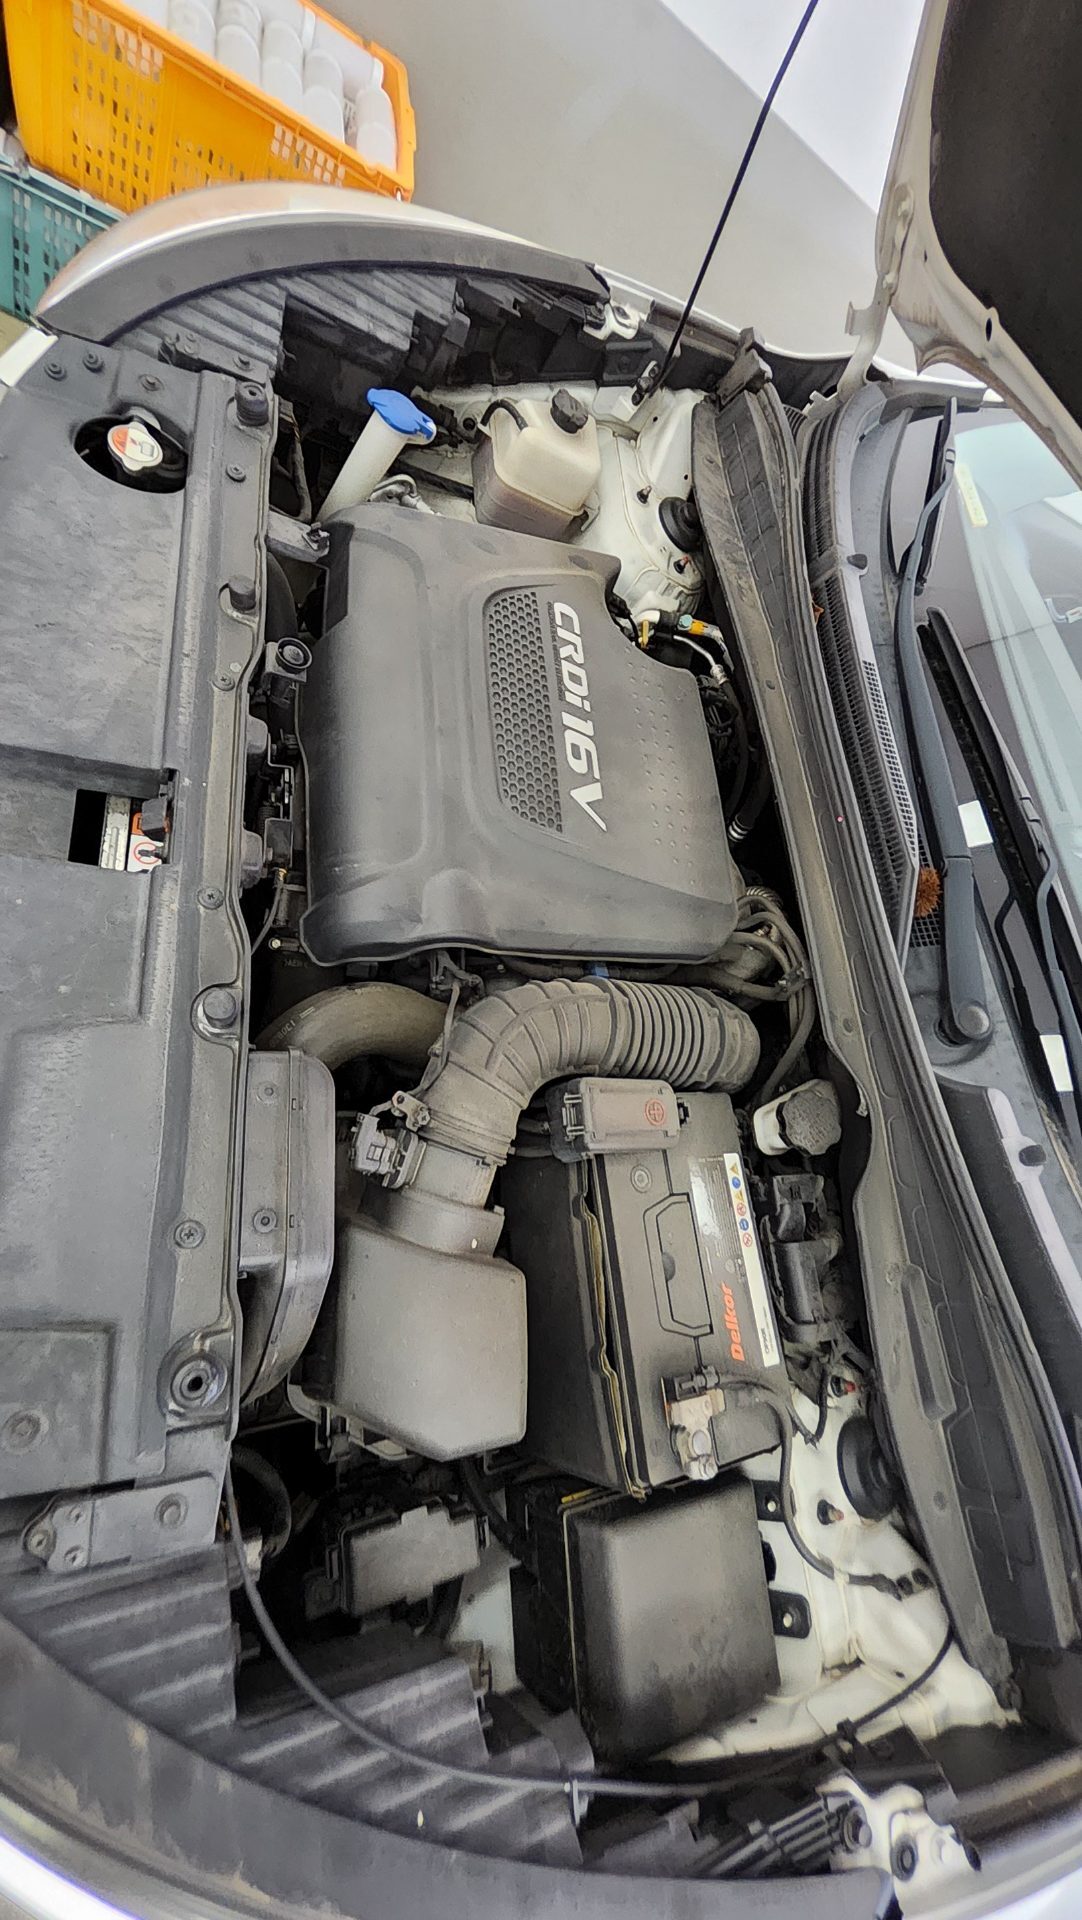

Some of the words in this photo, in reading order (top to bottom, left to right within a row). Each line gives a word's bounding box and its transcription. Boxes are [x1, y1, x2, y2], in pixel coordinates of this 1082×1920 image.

[553, 602, 591, 713] CRDi
[561, 711, 607, 832] 16V
[721, 1281, 745, 1362] Delkor
